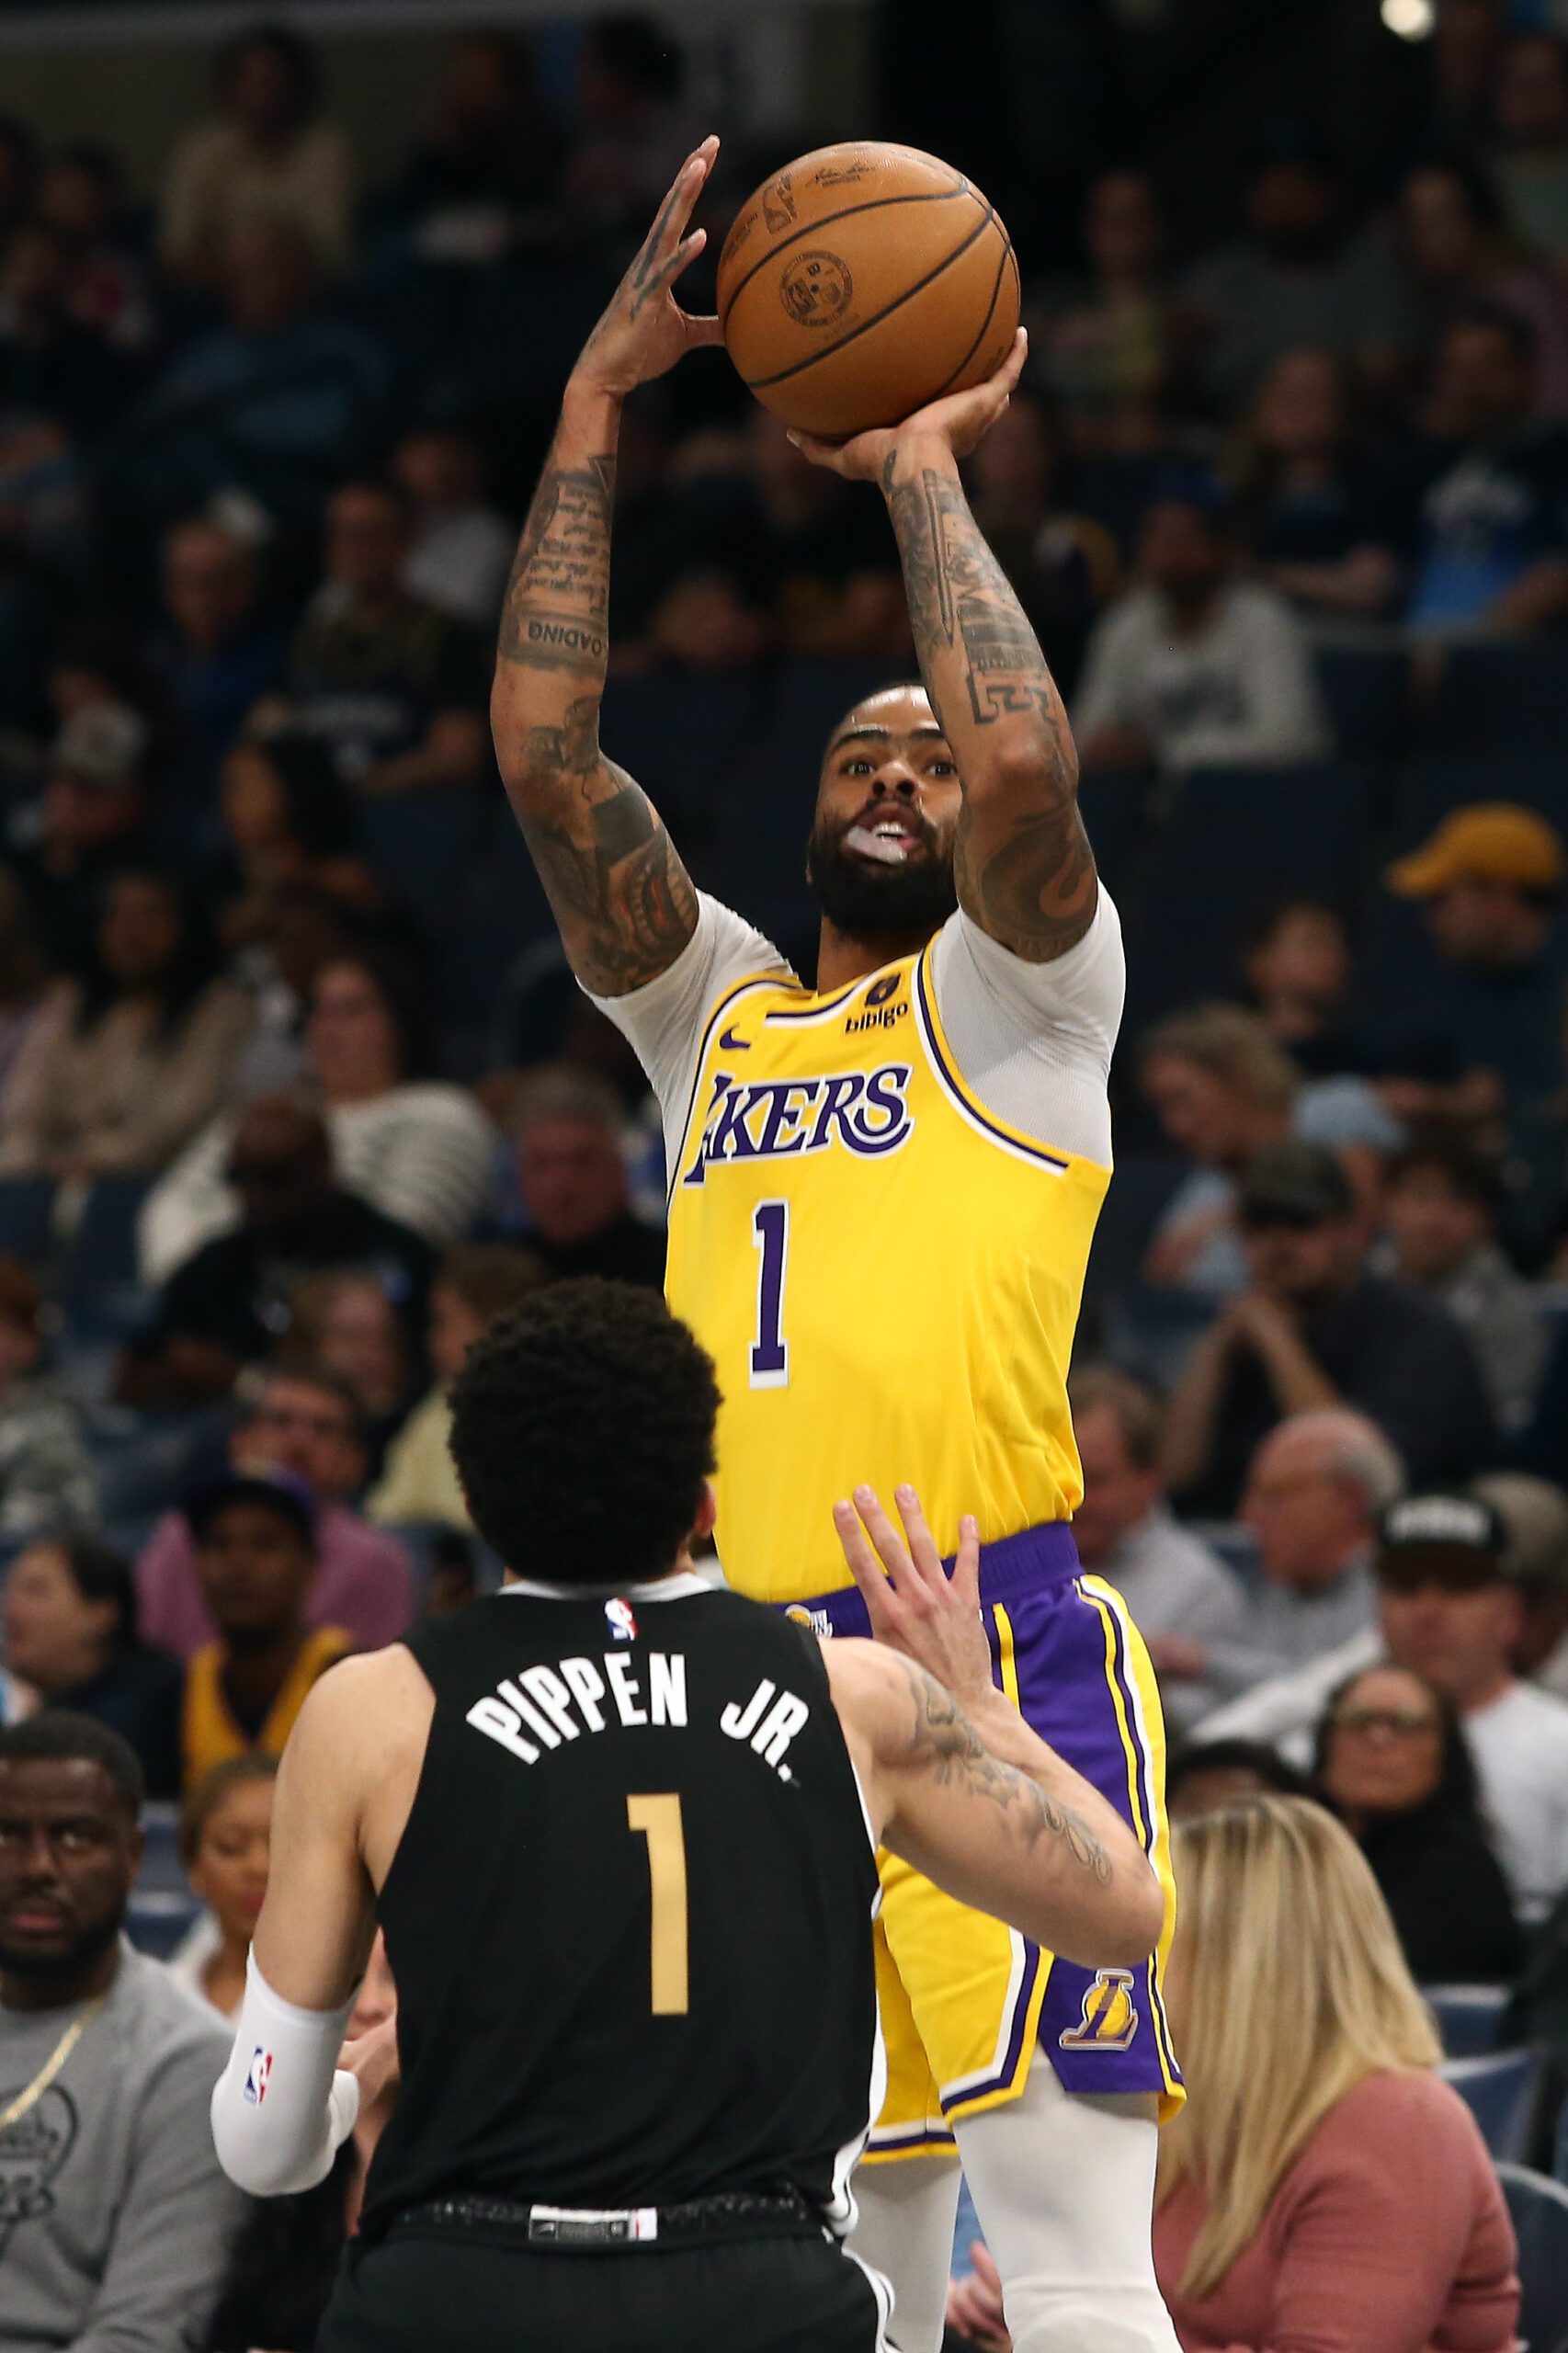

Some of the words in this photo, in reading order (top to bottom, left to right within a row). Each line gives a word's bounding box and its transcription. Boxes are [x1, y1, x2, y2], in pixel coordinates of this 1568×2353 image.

[528, 621, 607, 657] OADING
[844, 1002, 909, 1034] bibigo
[683, 1063, 915, 1187] KERS
[749, 1198, 790, 1390] 1
[465, 1652, 687, 1766] PIPPEN
[720, 1677, 810, 1782] JR.
[627, 1793, 688, 2016] 1
